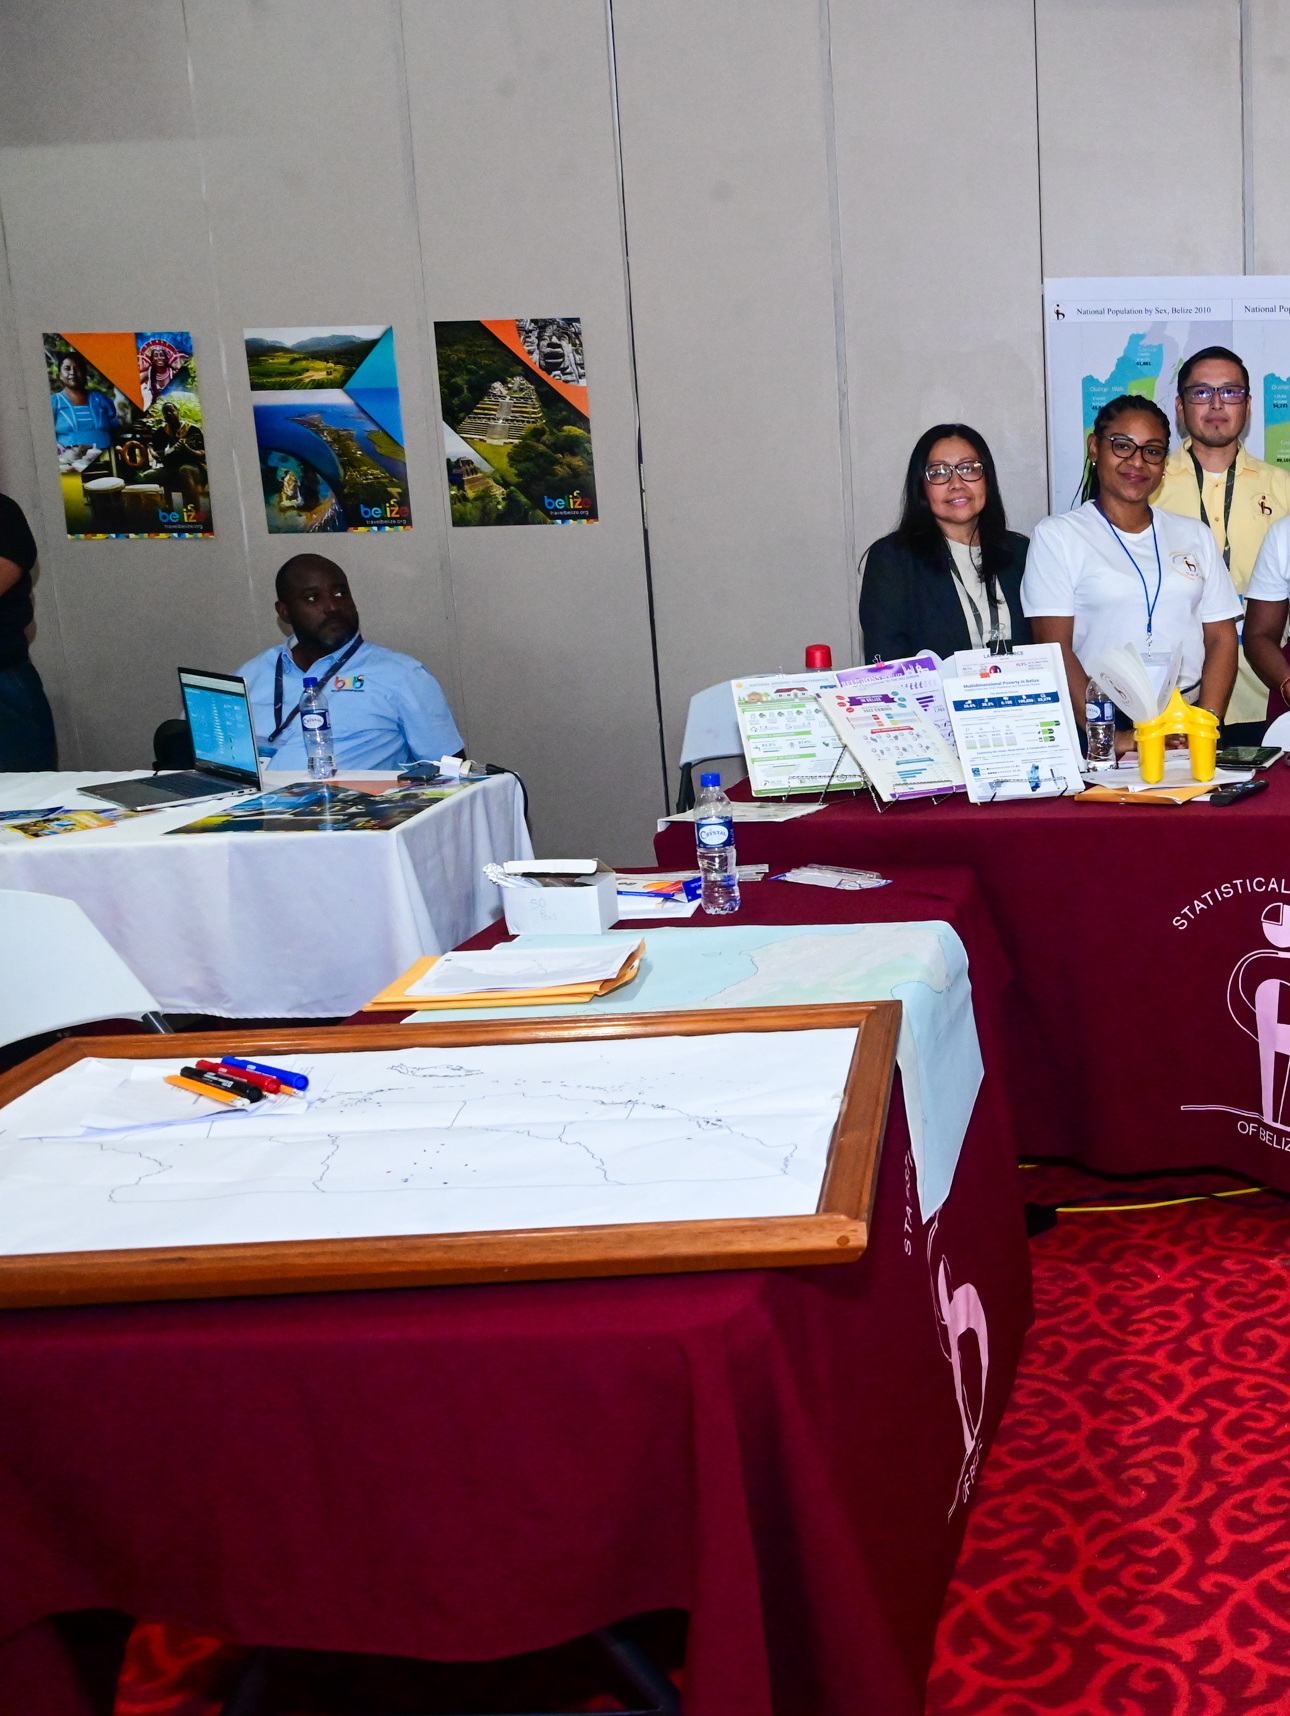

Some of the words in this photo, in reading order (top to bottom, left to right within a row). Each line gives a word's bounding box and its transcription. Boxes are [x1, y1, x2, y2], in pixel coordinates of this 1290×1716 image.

[1107, 308, 1142, 316] Population
[1144, 308, 1153, 316] by
[1154, 307, 1170, 316] Sex,
[1171, 306, 1192, 314] Belize
[1194, 306, 1212, 314] 2010
[1244, 304, 1277, 313] National
[544, 494, 592, 510] belize
[700, 830, 727, 840] CRYSTAL
[530, 898, 547, 910] 50
[1172, 877, 1290, 930] STATISTICAL
[540, 909, 558, 921] Pens
[1237, 1120, 1258, 1136] OF
